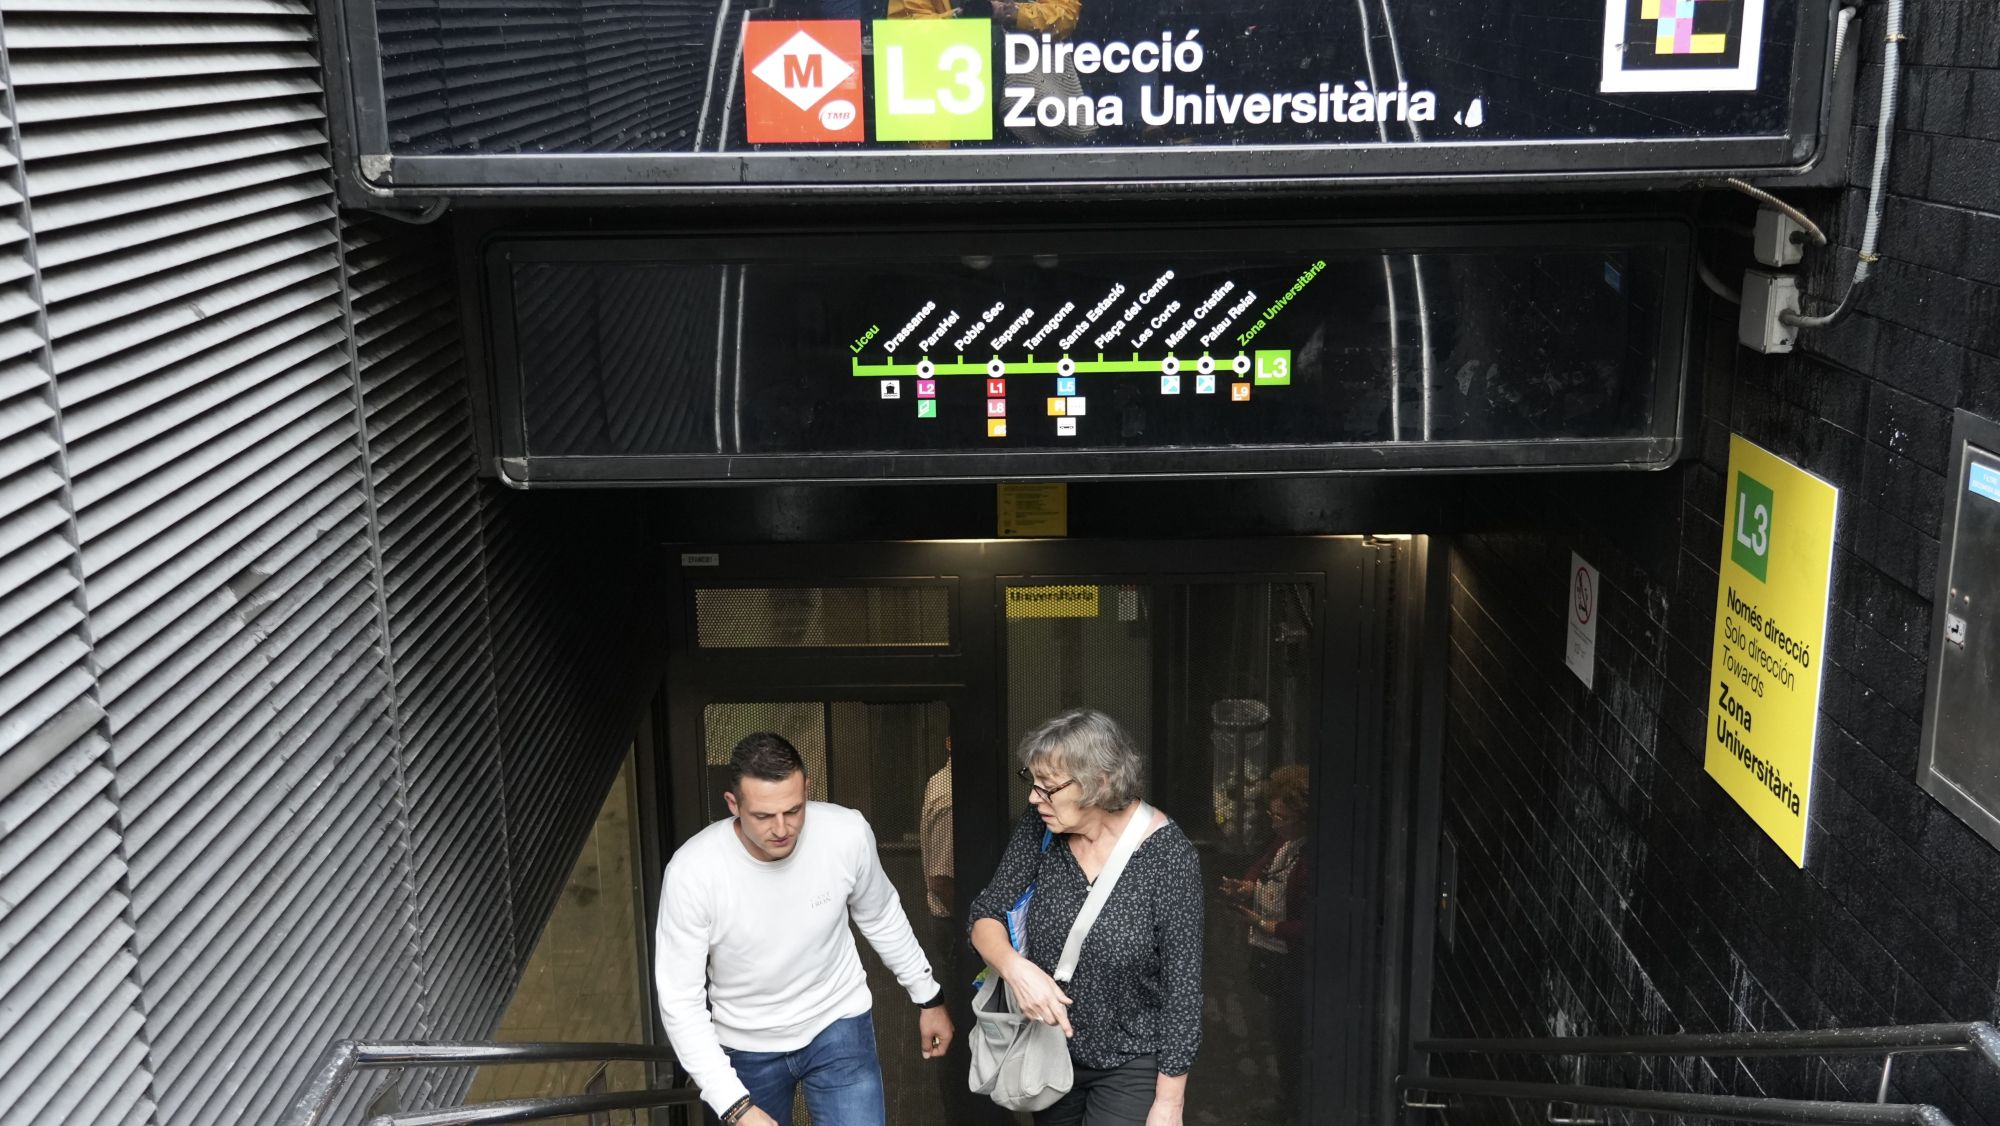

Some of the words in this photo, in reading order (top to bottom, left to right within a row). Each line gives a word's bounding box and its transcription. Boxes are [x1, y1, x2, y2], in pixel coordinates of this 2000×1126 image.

[783, 53, 823, 88] M
[1004, 30, 1203, 74] Direcció
[886, 45, 986, 117] L3
[1003, 88, 1124, 129] Zona
[1142, 80, 1437, 127] Universitària
[827, 112, 850, 120] TMB
[883, 300, 936, 353] Drassanes
[953, 320, 986, 352] Poble
[981, 301, 1005, 324] Sec
[1022, 301, 1075, 351] Tarragona
[1058, 320, 1090, 351] Sants
[1086, 282, 1126, 323] Estació
[1094, 316, 1126, 350] Plaça
[1123, 301, 1142, 322] del
[1138, 269, 1175, 304] Centre
[1130, 326, 1154, 349] Les
[1150, 299, 1181, 330] Corts
[1164, 316, 1197, 349] Maria
[1193, 279, 1235, 320] Cristina
[1199, 315, 1231, 348] Palau
[1227, 290, 1257, 321] Reial
[1237, 319, 1266, 347] Zona
[1263, 259, 1327, 321] Universitària
[850, 323, 880, 354] Liceu
[990, 307, 1035, 351] Espanya
[919, 383, 935, 395] L2
[990, 383, 1003, 394] L1
[1059, 380, 1075, 392] L5
[1257, 357, 1287, 378] L3
[988, 402, 1004, 413] L8
[1737, 492, 1768, 557] L3
[1727, 585, 1762, 632] Només
[1764, 617, 1809, 668] direcció
[1722, 644, 1764, 698] Towards
[1724, 616, 1746, 651] Solo
[1748, 637, 1795, 692] dirección
[1719, 681, 1751, 733] Zona
[1717, 714, 1800, 817] Universitària
